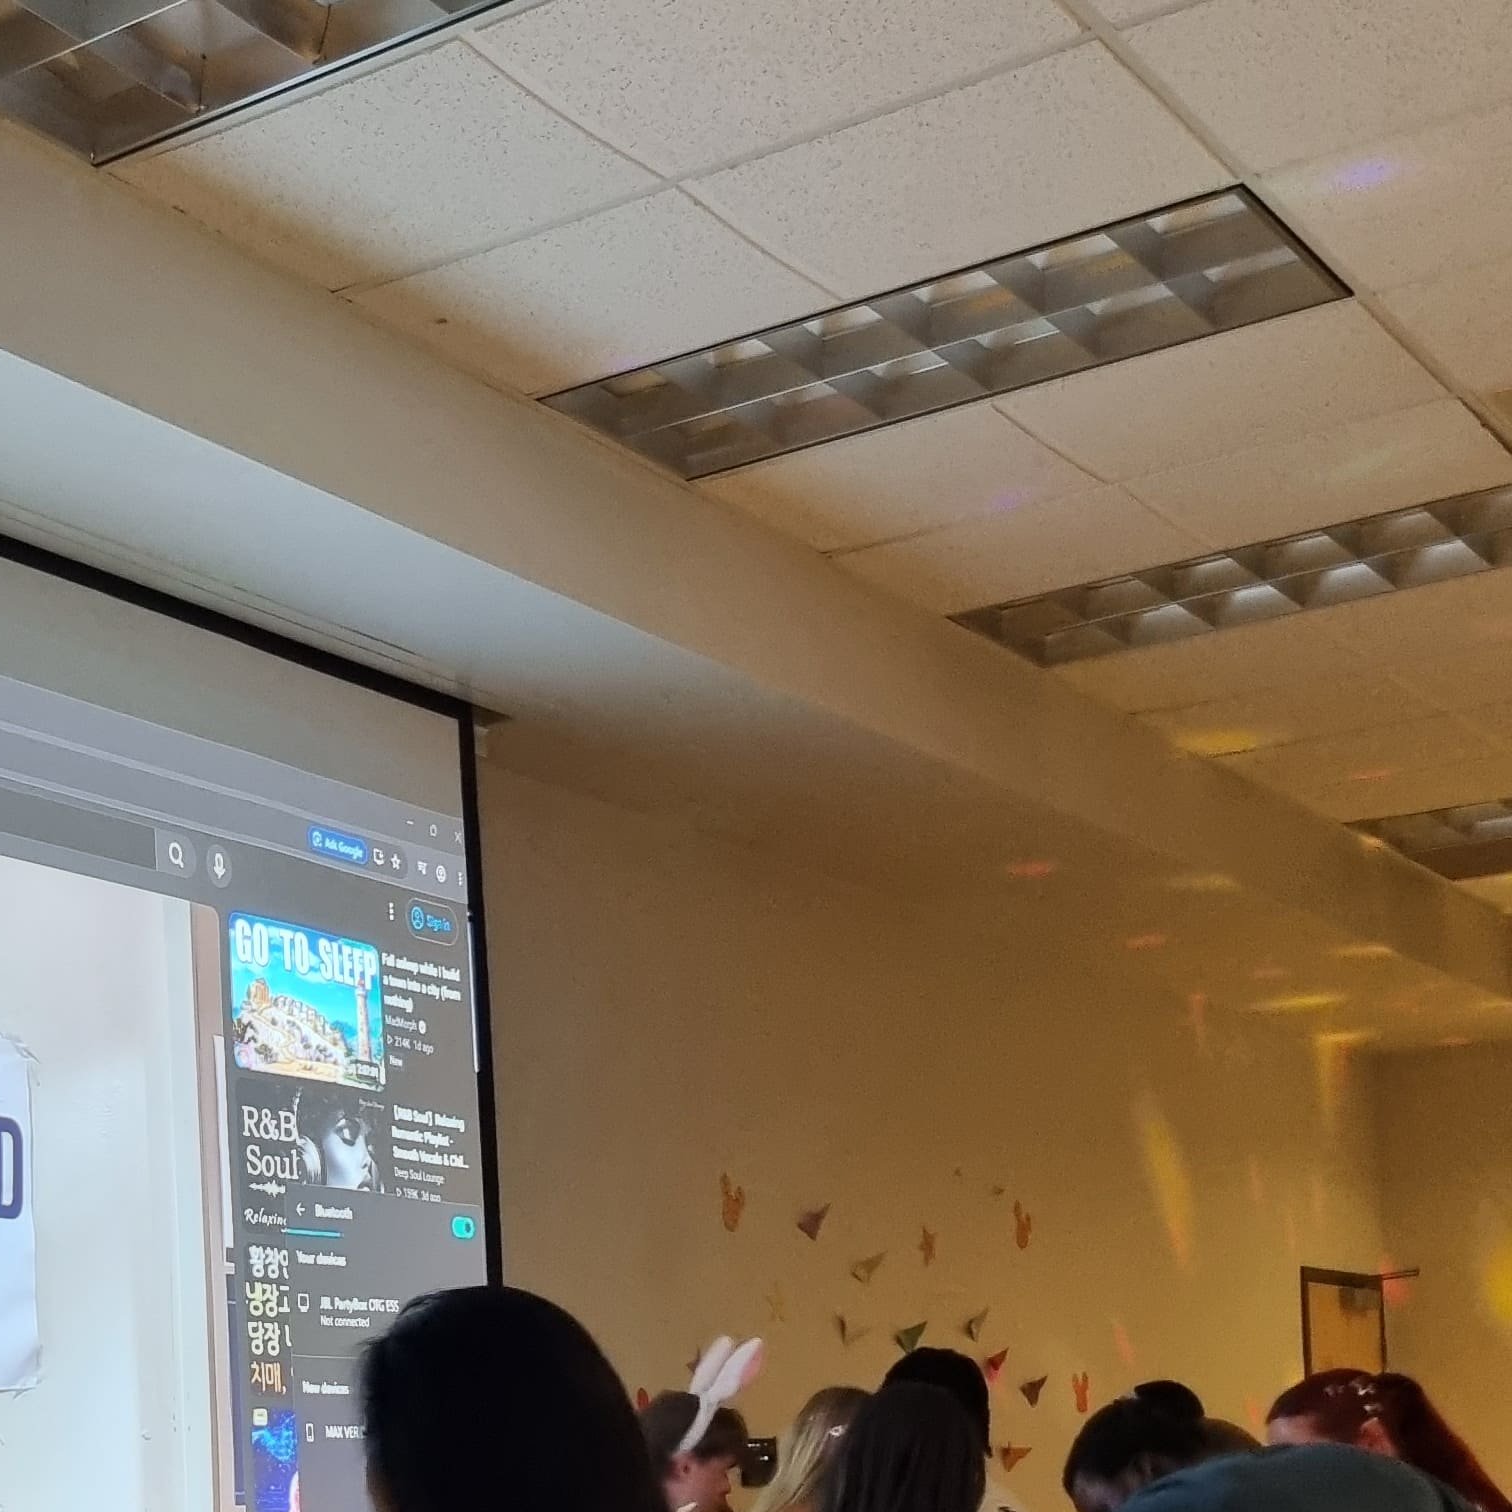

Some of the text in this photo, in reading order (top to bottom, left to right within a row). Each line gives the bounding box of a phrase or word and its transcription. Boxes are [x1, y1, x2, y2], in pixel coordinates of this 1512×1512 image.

[338, 841, 363, 860] Google
[235, 918, 377, 991] GO TO SLEEP
[422, 1044, 434, 1055] ago
[241, 1105, 297, 1141] R&B
[246, 1144, 299, 1180] Soul
[394, 1166, 408, 1180] Deep
[409, 1168, 422, 1181] Soul
[314, 1203, 353, 1220] Bluetooth
[296, 1250, 347, 1267] Your devices
[320, 1315, 370, 1328] Not connected
[325, 1425, 344, 1439] MAX
